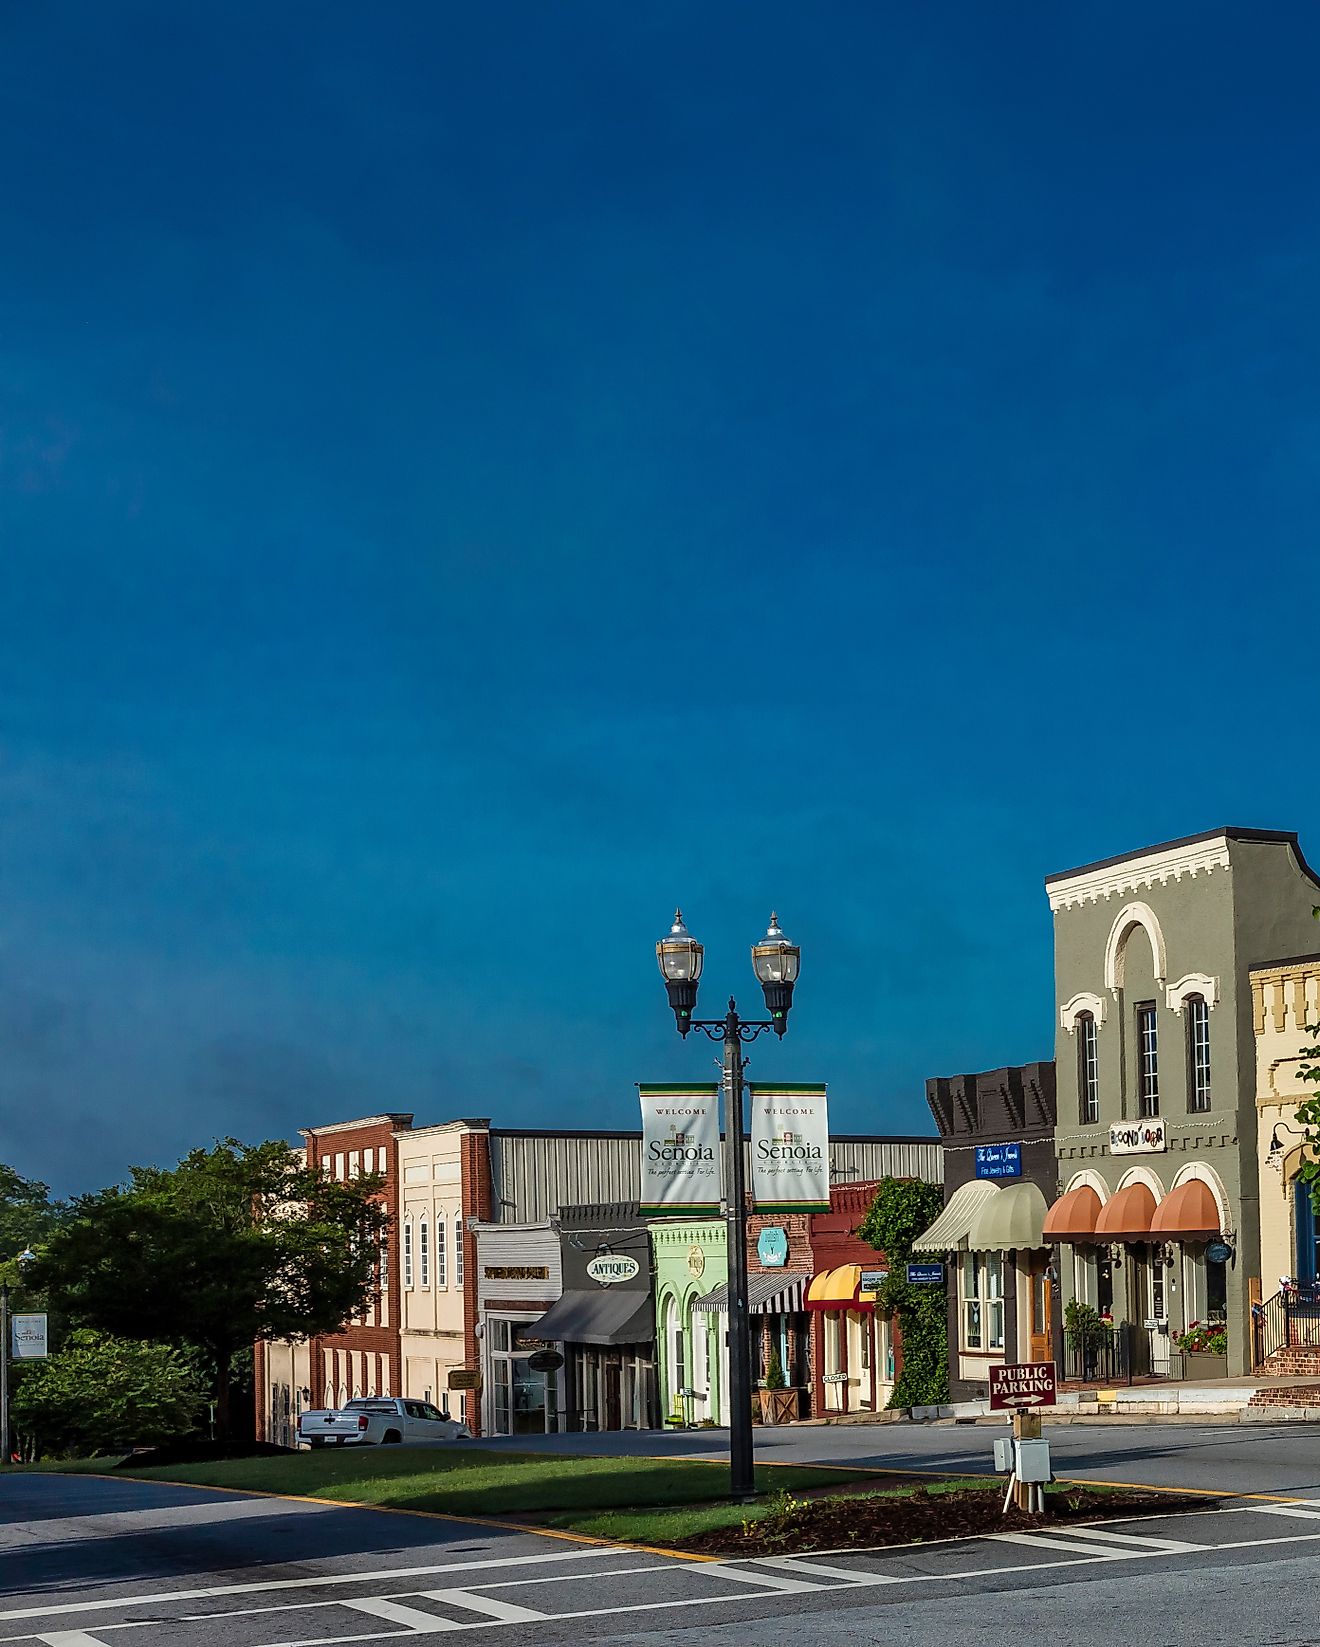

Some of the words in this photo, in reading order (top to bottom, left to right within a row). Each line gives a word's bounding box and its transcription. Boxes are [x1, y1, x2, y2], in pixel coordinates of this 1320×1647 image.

[648, 1140, 715, 1161] Senoia
[757, 1139, 823, 1160] Senoia
[658, 1167, 676, 1178] perfect
[768, 1165, 786, 1176] perfect
[592, 1261, 636, 1275] ANTIQUES
[15, 1332, 45, 1341] Senoia
[823, 1374, 847, 1383] CLOSED
[998, 1366, 1047, 1382] PUBLIC
[992, 1378, 1054, 1395] PARKING
